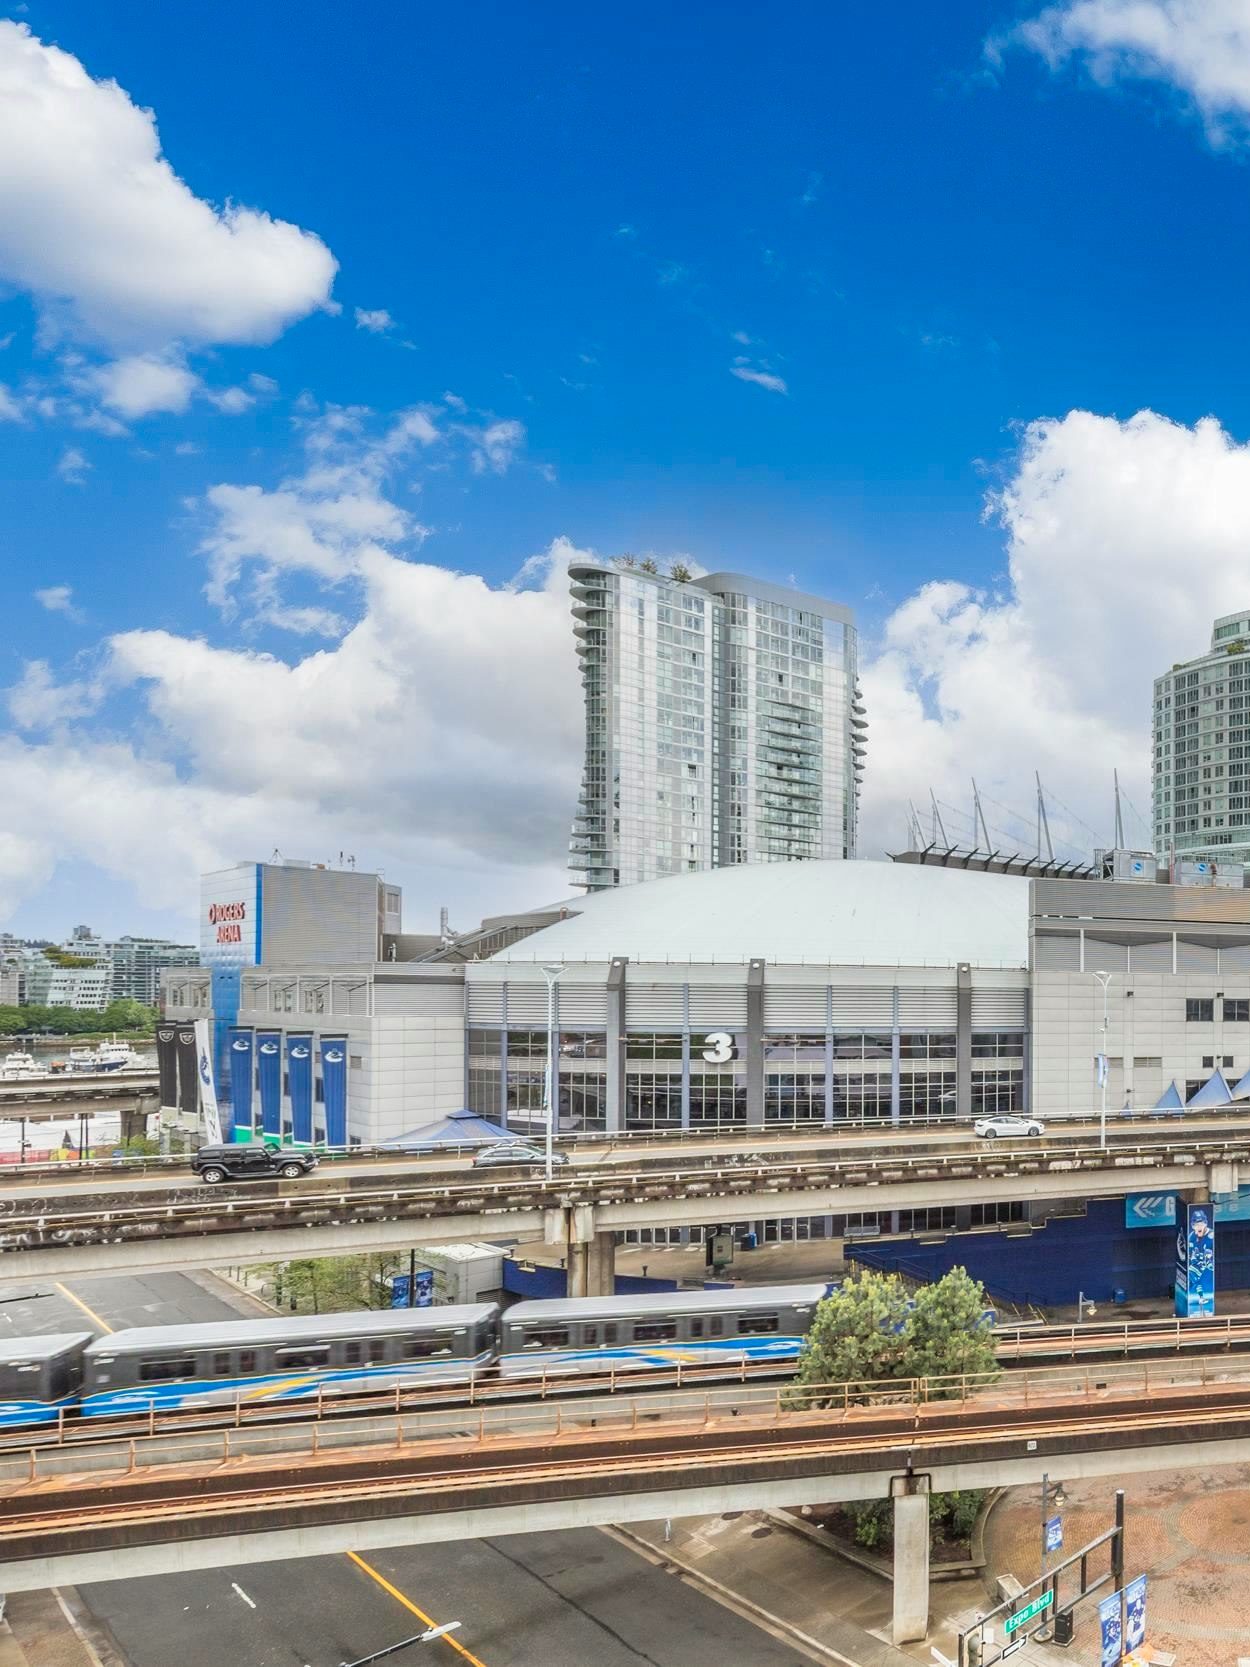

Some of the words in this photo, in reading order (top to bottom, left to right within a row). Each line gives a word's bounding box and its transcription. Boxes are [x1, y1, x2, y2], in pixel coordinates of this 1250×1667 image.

[215, 902, 245, 922] ROGERS
[217, 925, 241, 943] ARENA
[702, 1032, 733, 1063] 3
[1009, 1608, 1029, 1628] Expo
[1031, 1592, 1050, 1613] Blvd
